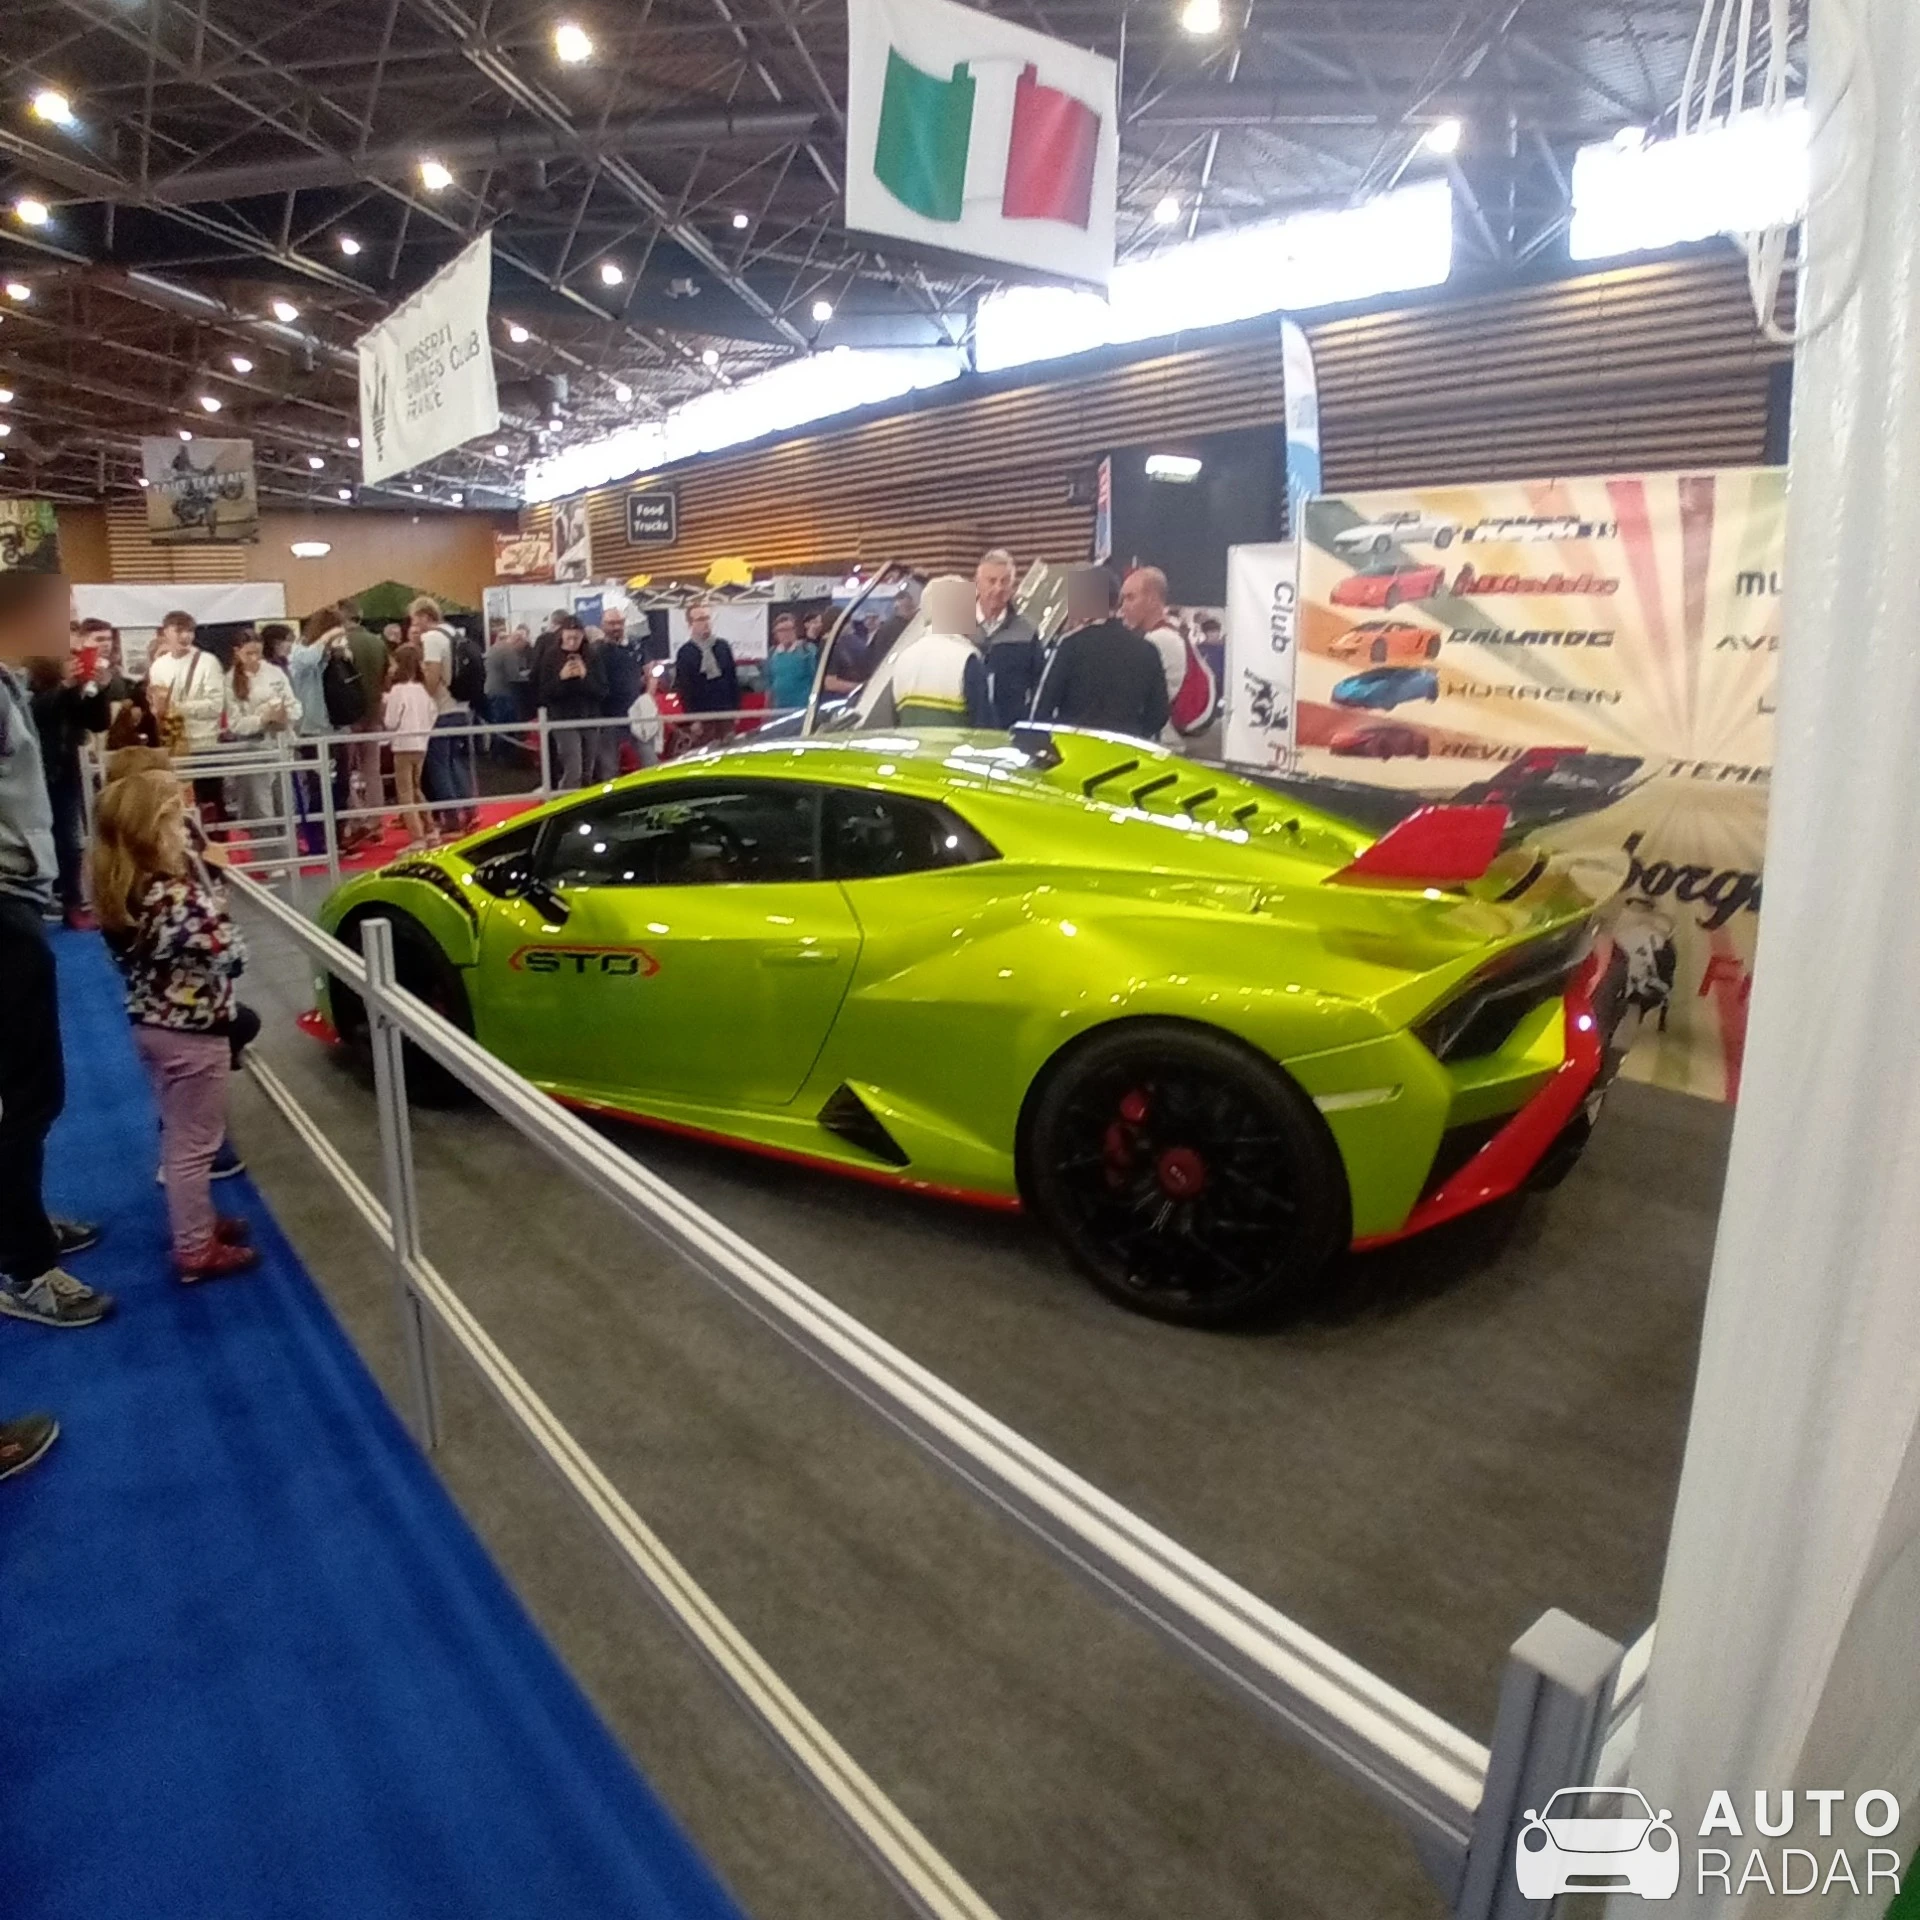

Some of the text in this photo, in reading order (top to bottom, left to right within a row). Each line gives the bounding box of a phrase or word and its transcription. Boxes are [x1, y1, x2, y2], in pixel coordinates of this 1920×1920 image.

[636, 503, 664, 517] Food
[633, 520, 669, 532] Trucks
[1270, 580, 1295, 655] Club
[525, 952, 639, 976] STO
